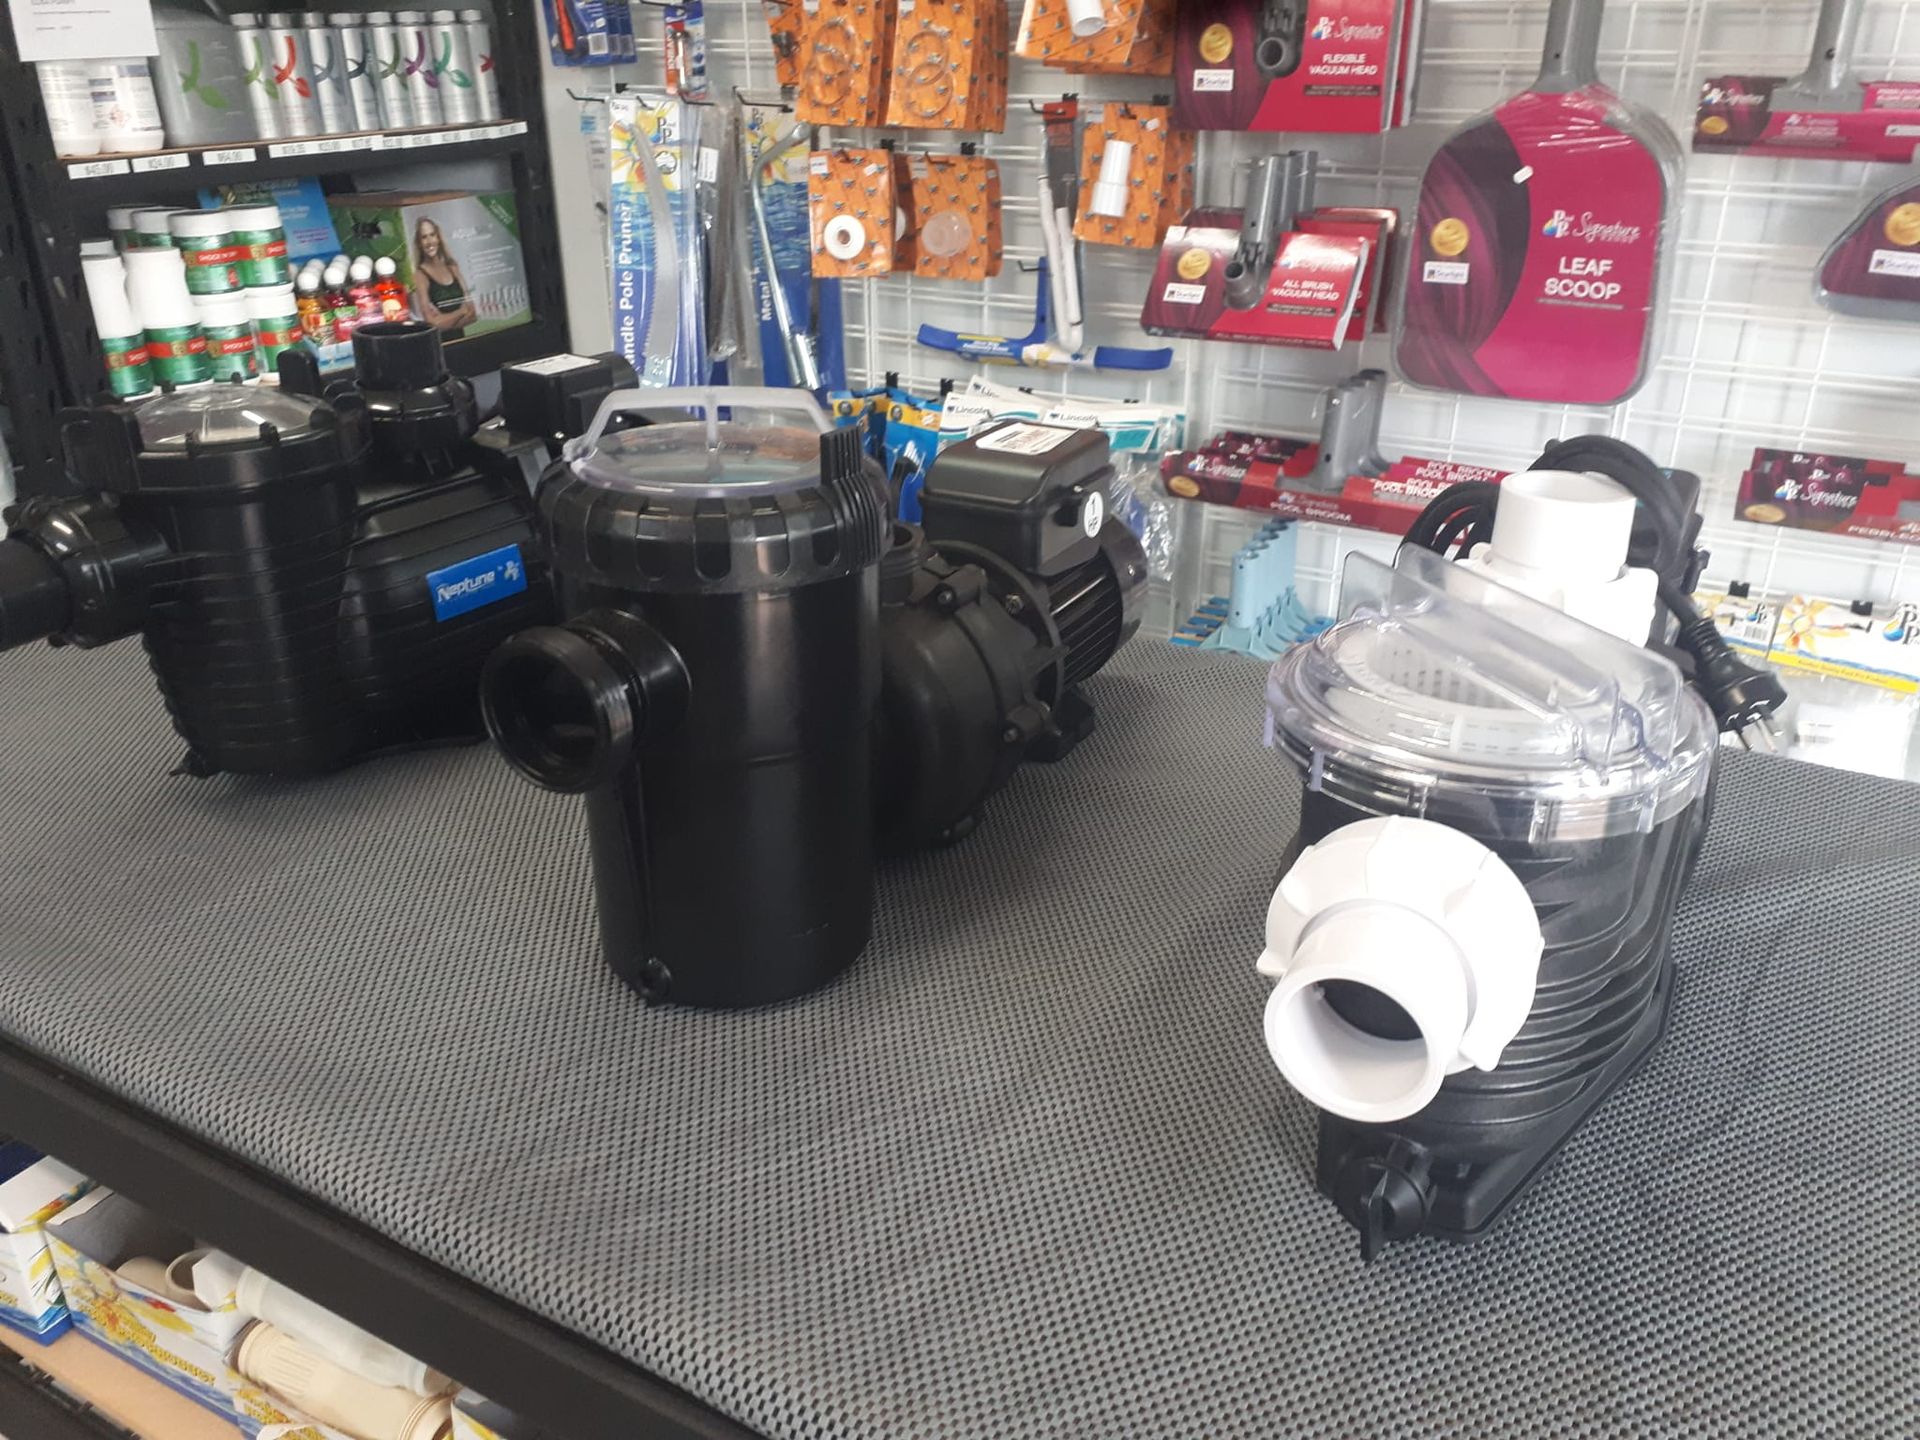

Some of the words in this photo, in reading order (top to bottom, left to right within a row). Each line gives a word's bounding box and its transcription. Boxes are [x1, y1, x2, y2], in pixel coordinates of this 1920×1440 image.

[1334, 16, 1384, 42] Signature
[1322, 53, 1367, 64] FLEXIBLE
[1309, 65, 1350, 75] VACUUM
[1351, 65, 1378, 76] HEAD
[618, 201, 633, 265] Pruner
[1572, 211, 1641, 243] Signature
[1558, 256, 1614, 277] LEAF
[618, 269, 633, 310] Pole
[1271, 288, 1313, 299] VACUUM
[1312, 290, 1340, 301] HEAD
[1282, 279, 1300, 288] ALL
[1301, 280, 1335, 291] BRUSH
[1544, 277, 1622, 300] SCOOP
[761, 281, 773, 321] Metal
[620, 314, 635, 366] andle
[954, 405, 991, 416] Lincoln
[1059, 412, 1099, 423] Lincoln
[1415, 467, 1445, 479] POOL
[1427, 461, 1454, 472] POOL
[1373, 480, 1404, 494] POOL
[1404, 483, 1441, 498] BROO
[1800, 482, 1858, 508] Signature
[1269, 501, 1303, 513] POOL
[1304, 508, 1352, 522] BROOM
[436, 570, 496, 603] Neptune
